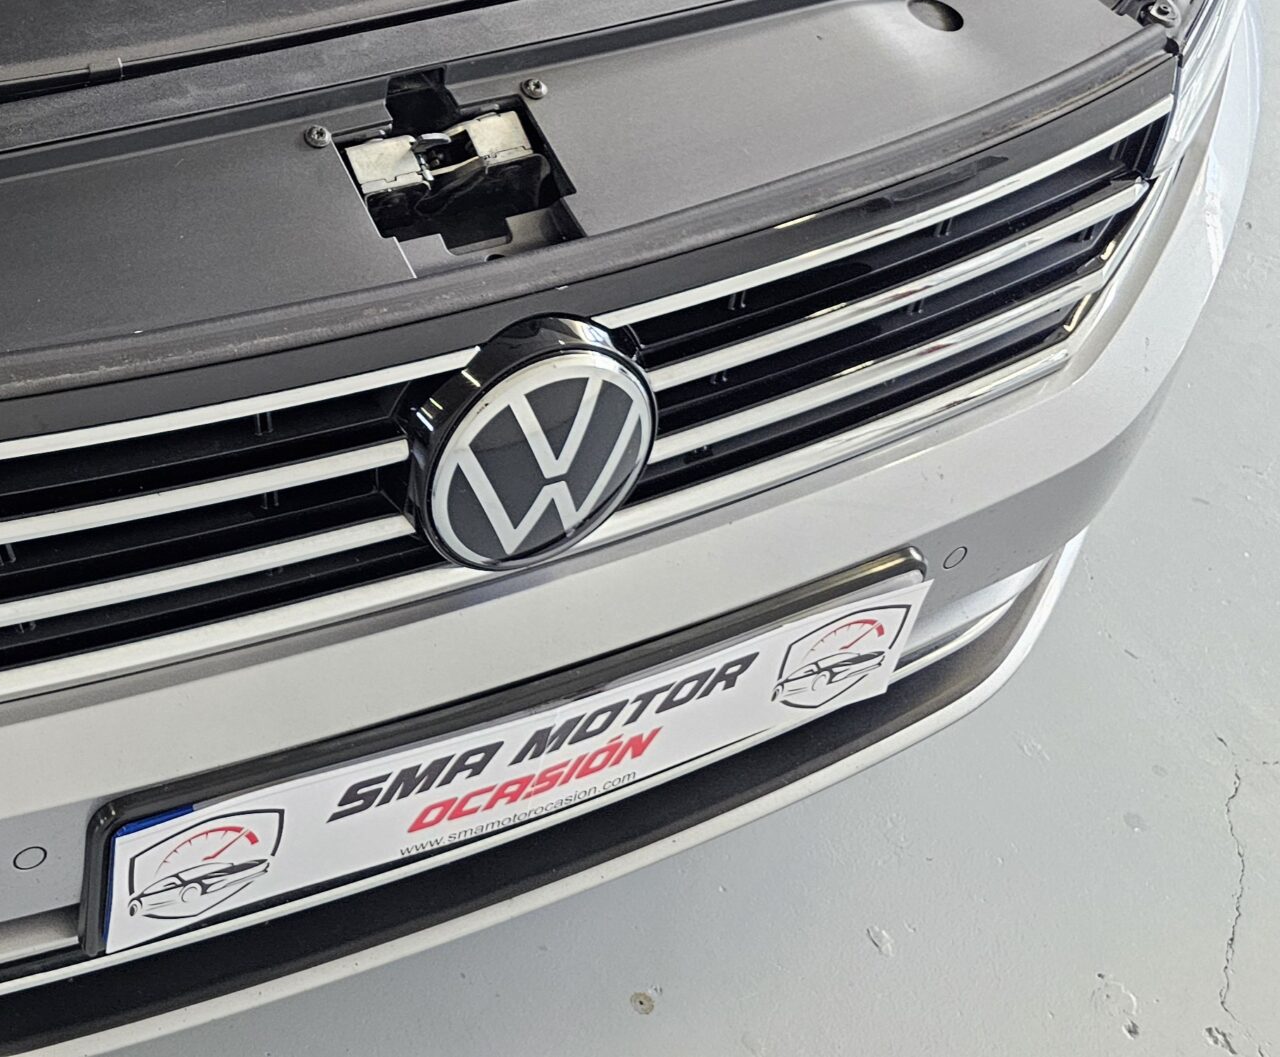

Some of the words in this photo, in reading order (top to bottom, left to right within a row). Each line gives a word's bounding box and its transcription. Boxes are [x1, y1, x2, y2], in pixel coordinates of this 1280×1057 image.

[326, 741, 504, 823] SMA
[508, 652, 760, 766] MOTOR
[407, 726, 664, 833] OCASIÓN
[399, 771, 637, 856] www.smamotorocasion.com
